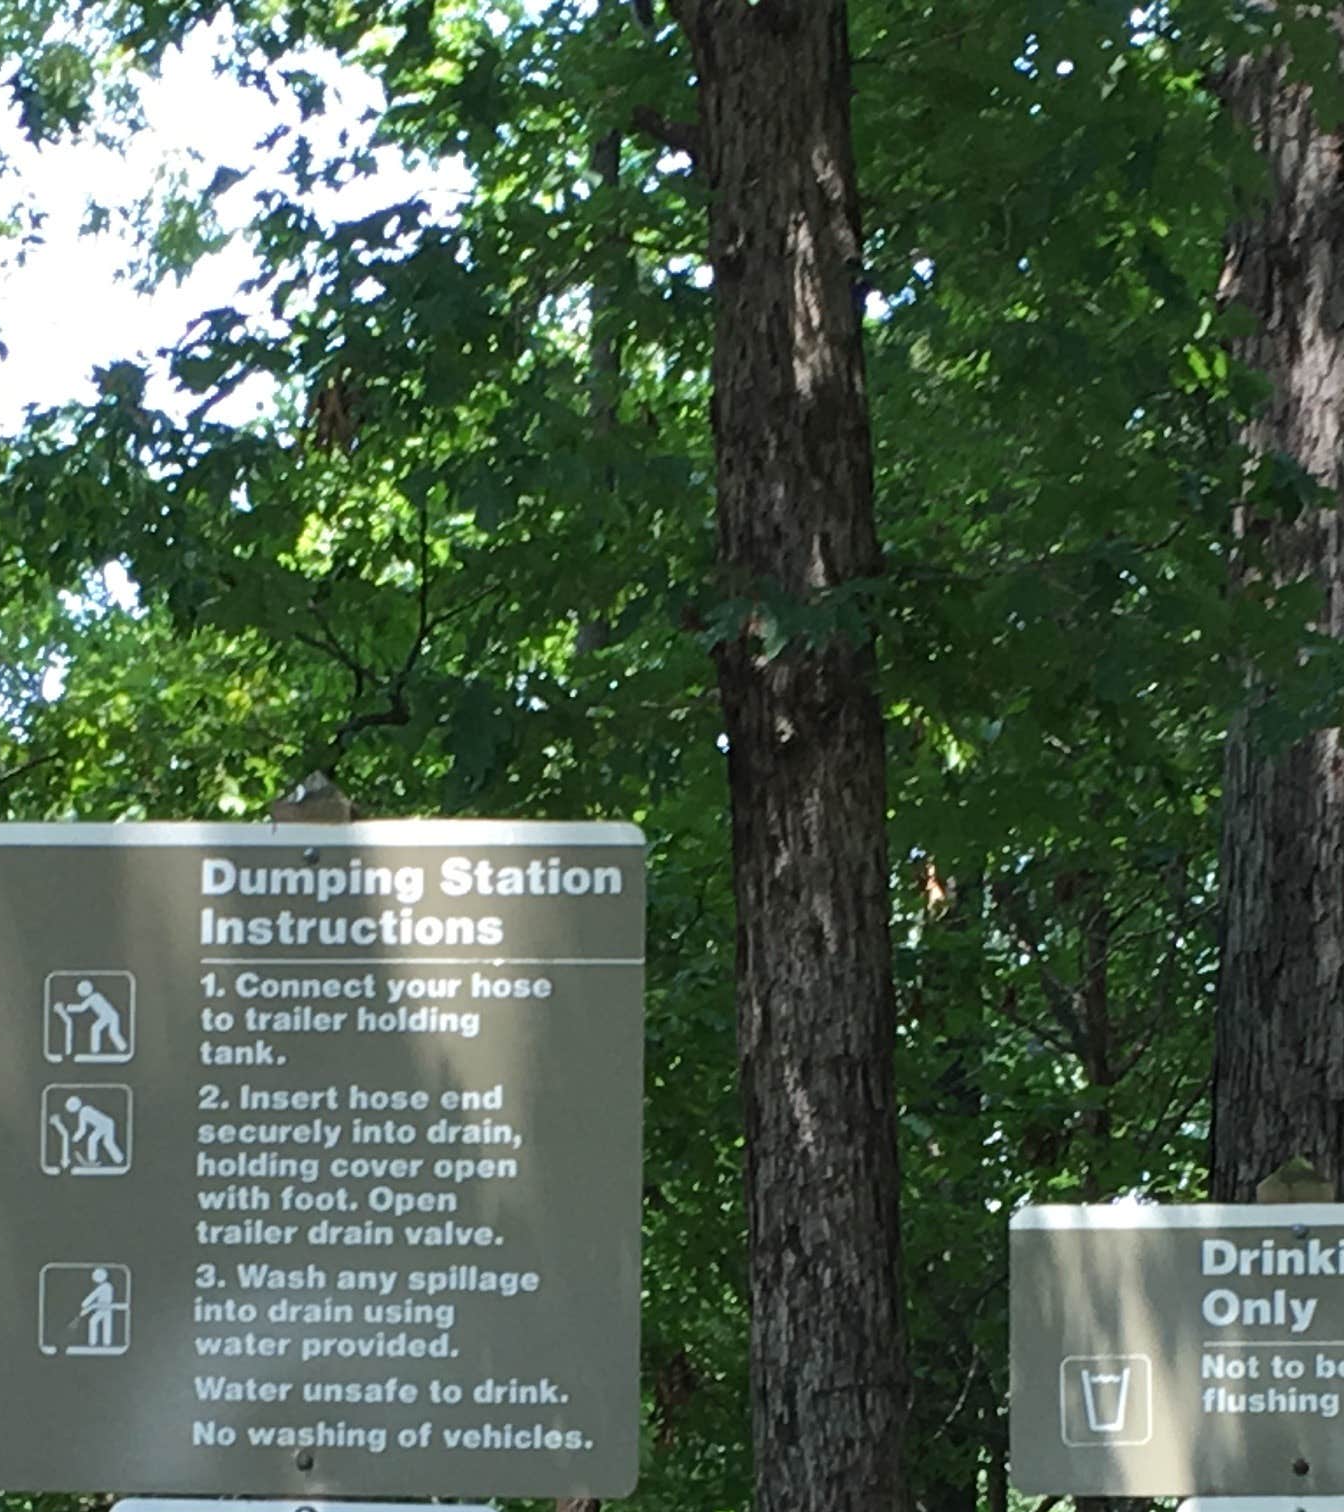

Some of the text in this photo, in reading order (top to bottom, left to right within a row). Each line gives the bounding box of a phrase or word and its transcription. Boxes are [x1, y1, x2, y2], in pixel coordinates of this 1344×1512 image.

[201, 857, 622, 902] Dumping Station
[201, 910, 503, 945] Instructions
[202, 974, 552, 1004] 1. Connect your hose
[202, 1008, 480, 1038] to trailer holding
[200, 1041, 287, 1066] tank.
[200, 1086, 503, 1110] 2. Insert hose end
[198, 1120, 521, 1150] securely into drain,
[197, 1153, 517, 1183] holding cover open
[198, 1187, 457, 1217] with foot. Open
[197, 1222, 504, 1246] trailer drain valve.
[196, 1265, 539, 1295] 3. Wash any spillage
[194, 1298, 455, 1329] into drain using
[1202, 1290, 1318, 1332] Only
[196, 1333, 458, 1363] water provided.
[1202, 1354, 1259, 1379] Not
[1270, 1355, 1304, 1379] to
[194, 1377, 568, 1405] Water unsafe to drink.
[1202, 1388, 1340, 1417] flushing
[193, 1422, 594, 1452] No washing of vehicles.
